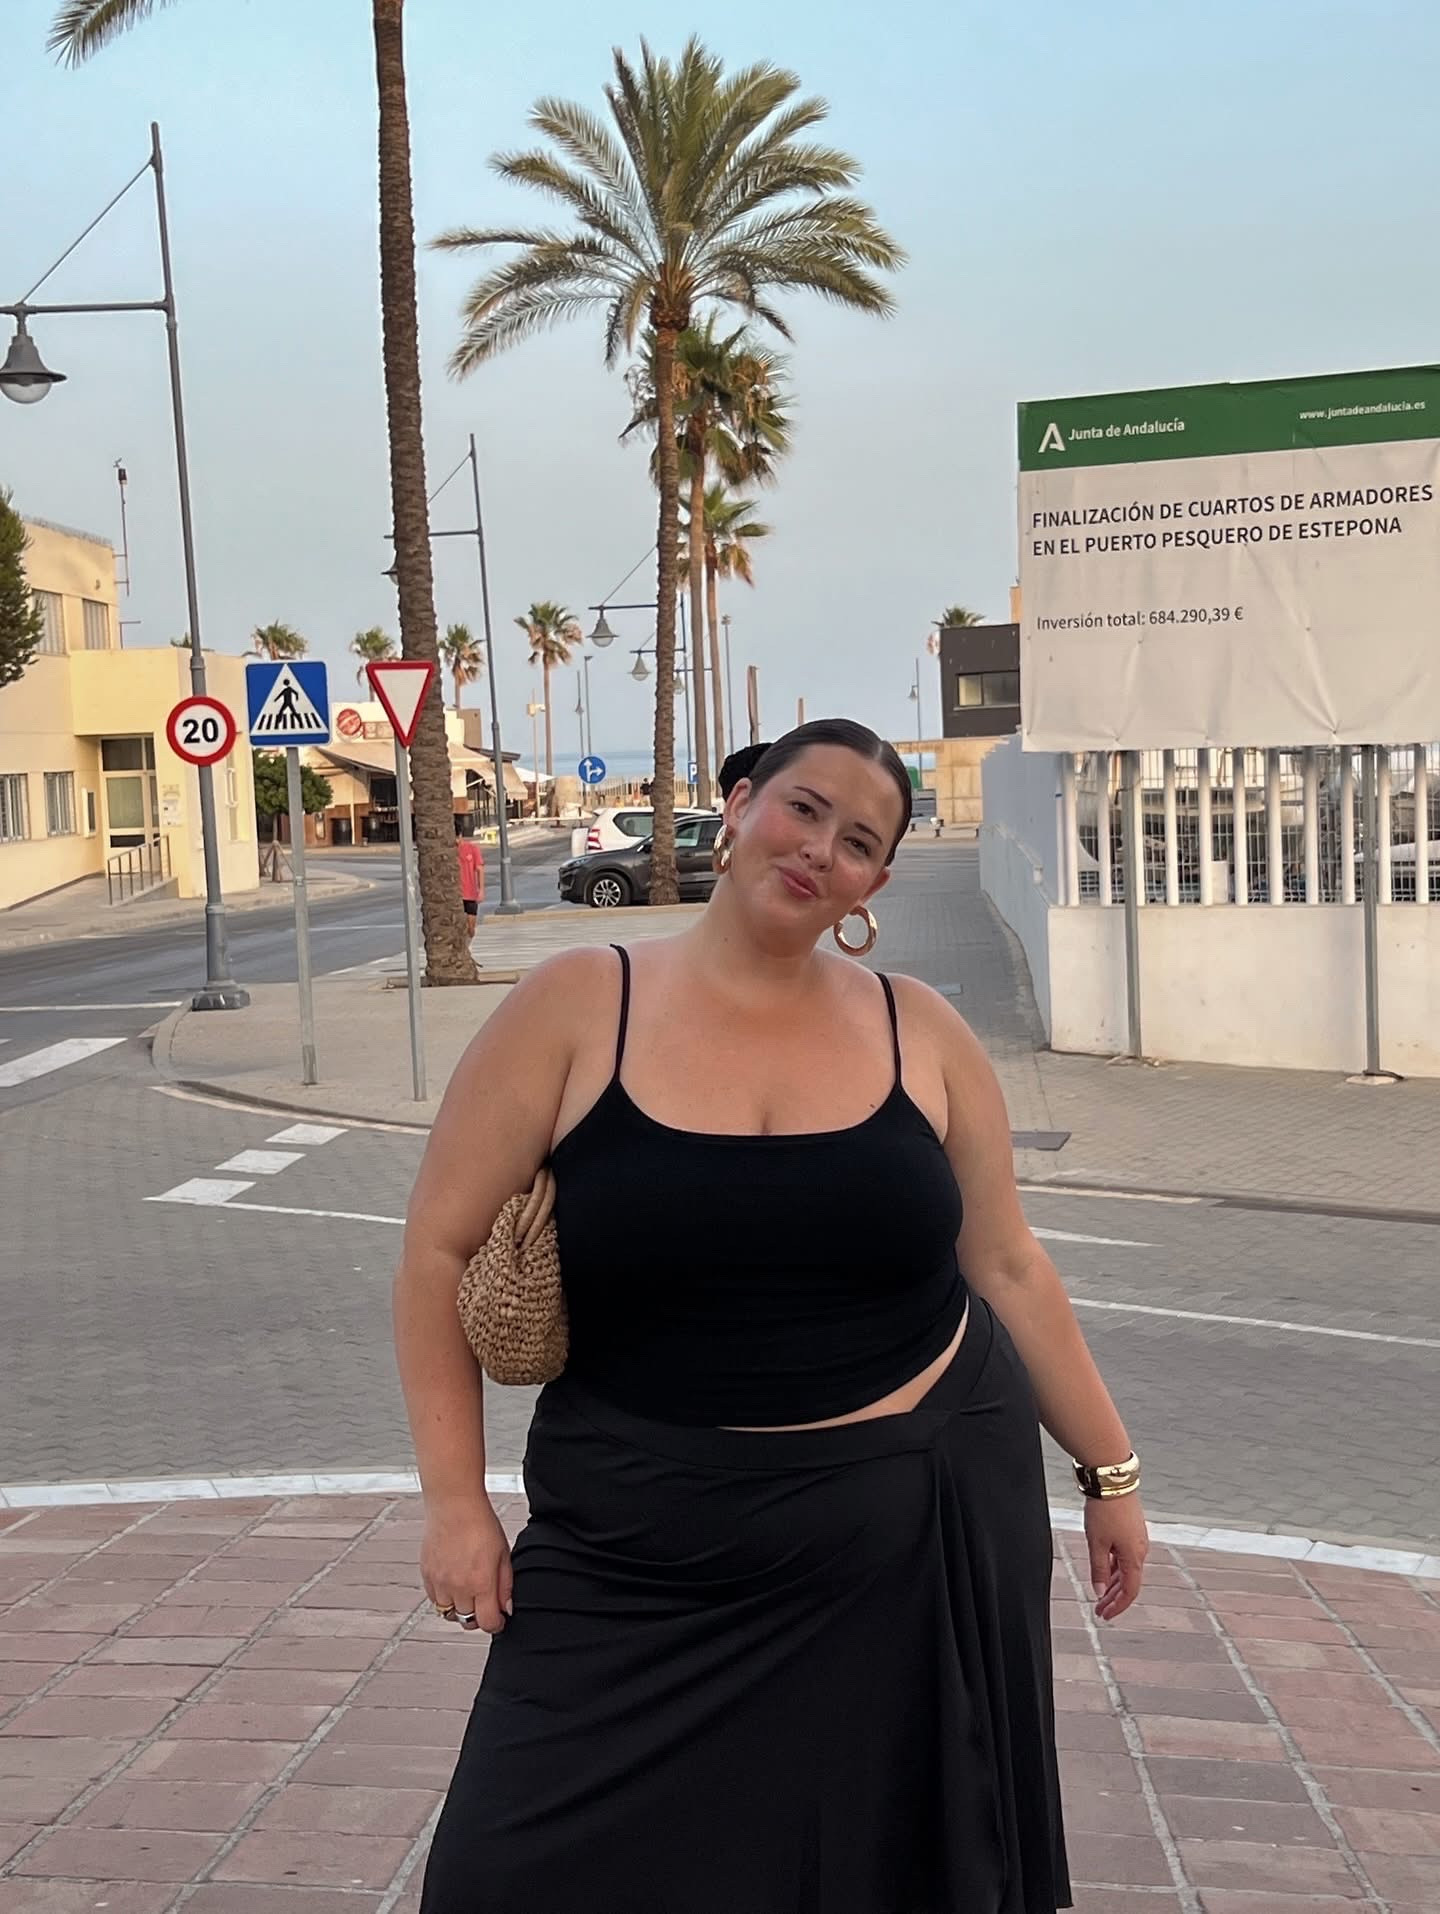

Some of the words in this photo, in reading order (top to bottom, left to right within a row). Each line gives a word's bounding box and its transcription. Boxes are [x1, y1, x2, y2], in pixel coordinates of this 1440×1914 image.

[1068, 428, 1103, 441] Junta
[1105, 424, 1121, 437] de
[1123, 417, 1185, 436] Andalucía
[1033, 501, 1154, 529] FINALIZACIÓN
[1160, 502, 1183, 520] DE
[1188, 495, 1275, 518] CUARTOS
[1280, 493, 1305, 511] DE
[1309, 484, 1433, 509] ARMADORES
[1033, 540, 1055, 556] EN
[1060, 539, 1080, 554] EL
[1085, 534, 1156, 553] PUERTO
[1162, 526, 1263, 549] PESQUERO
[1269, 524, 1293, 541] DE
[1298, 516, 1402, 539] ESTEPONA
[1037, 611, 1103, 630] Inversión
[1107, 611, 1146, 627] total:
[1149, 607, 1230, 625] 684.290,39
[1234, 606, 1244, 621] €
[182, 717, 219, 744] 20
